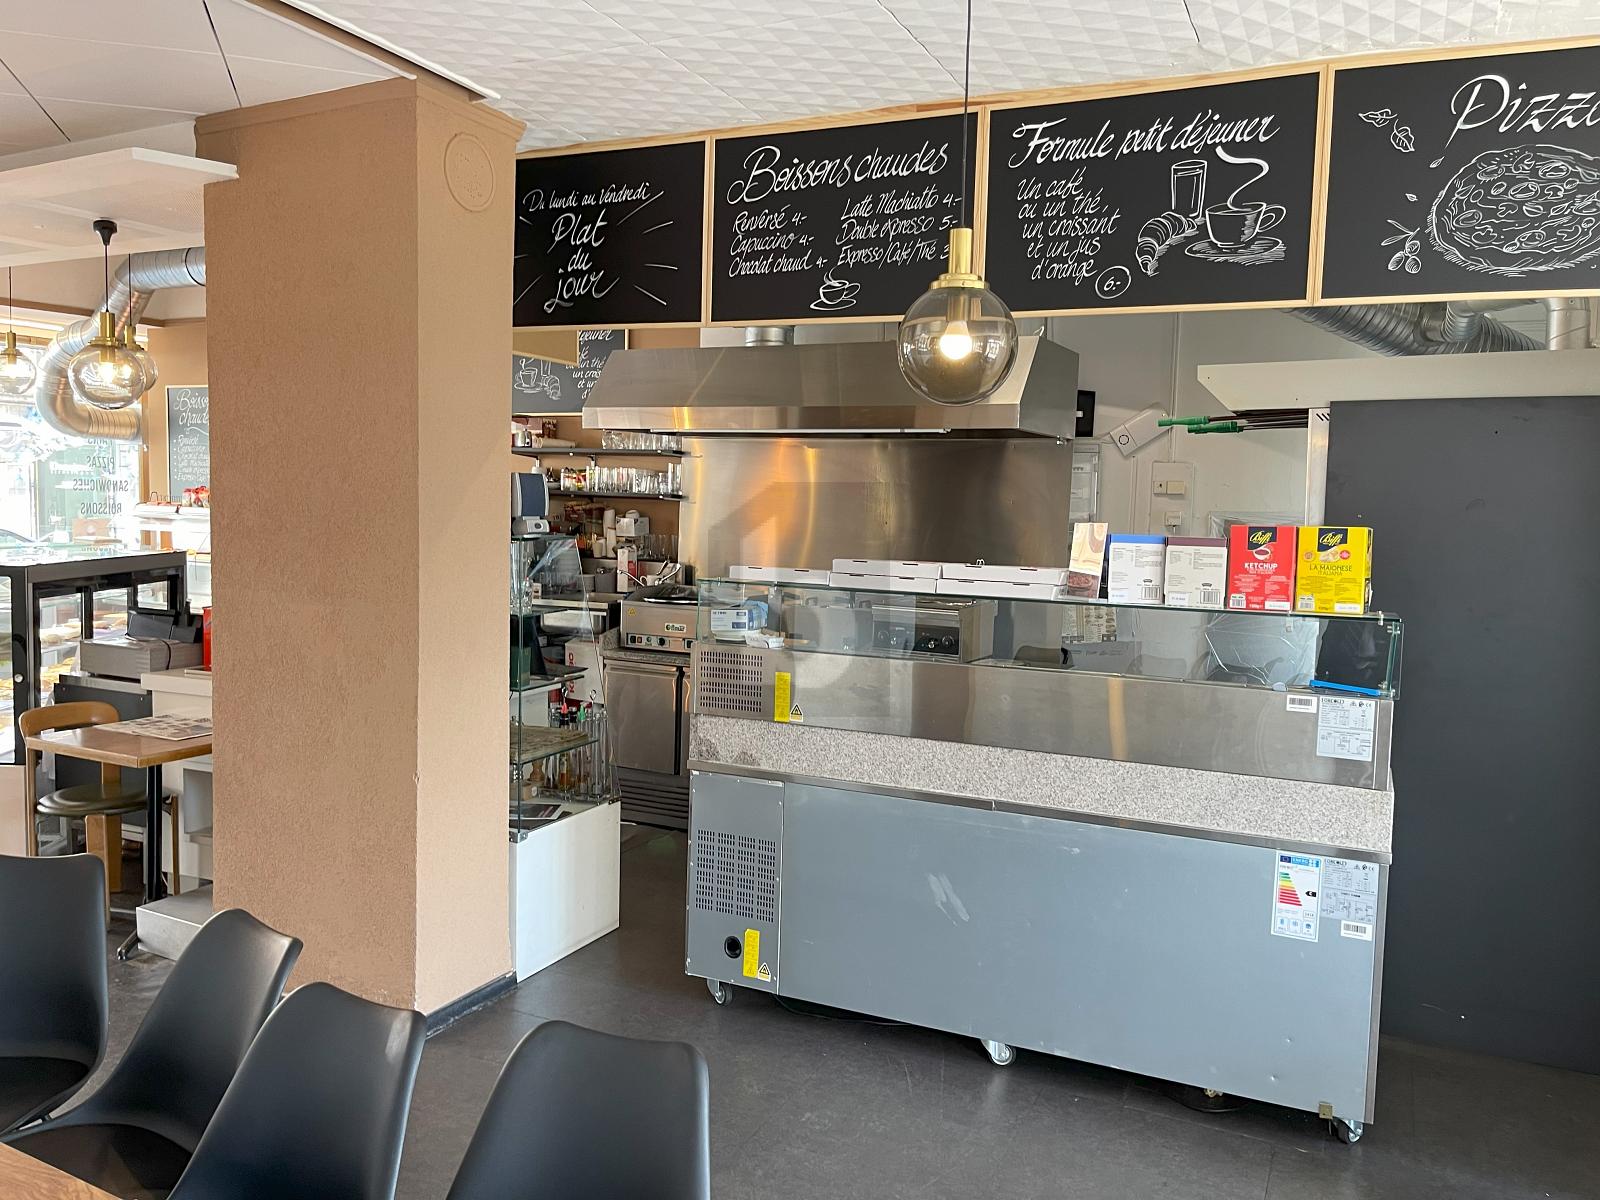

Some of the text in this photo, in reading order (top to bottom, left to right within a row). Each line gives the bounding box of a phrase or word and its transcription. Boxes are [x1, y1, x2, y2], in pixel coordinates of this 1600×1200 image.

[1008, 109, 1280, 169] Formule petit déjeuner
[727, 141, 949, 204] Boissons chaudes
[1017, 166, 1087, 201] Un café
[522, 182, 651, 212] Du lundi au Vendredi
[840, 193, 874, 220] Latte
[876, 184, 939, 215] Machiatto
[1018, 203, 1038, 219] ou
[1043, 201, 1067, 217] un
[547, 208, 608, 254] Plat
[732, 204, 791, 235] Renversé
[835, 219, 880, 245] Double
[1022, 208, 1121, 239] un croissant
[567, 247, 593, 272] du
[730, 232, 801, 259] Capuccino
[1027, 235, 1101, 265] et un jus
[728, 253, 774, 278] Chocolat
[773, 249, 814, 273] chaud
[1031, 258, 1098, 286] d'orange
[543, 268, 620, 313] jour
[1244, 562, 1278, 571] KETCHUP
[1309, 563, 1319, 571] LA
